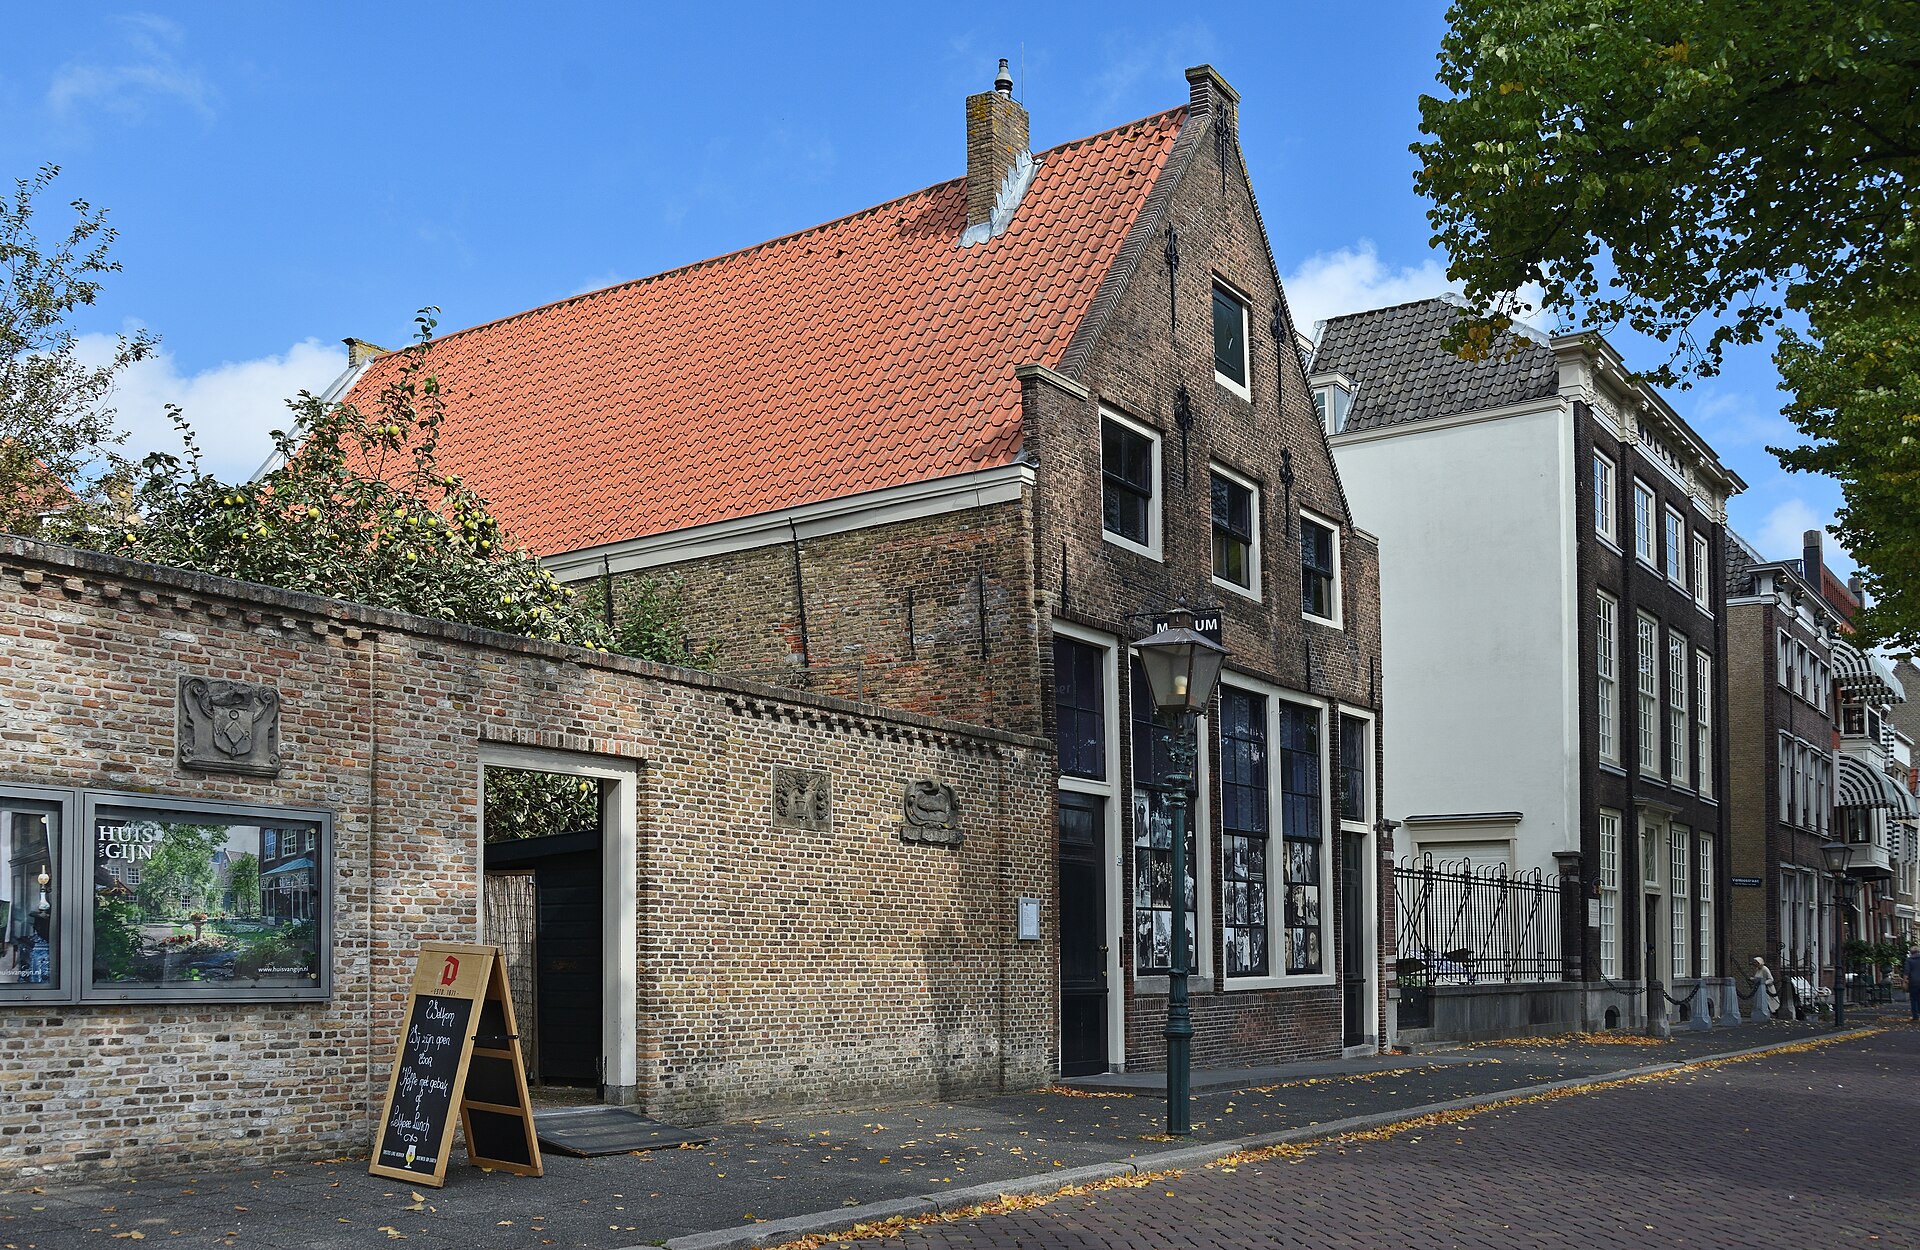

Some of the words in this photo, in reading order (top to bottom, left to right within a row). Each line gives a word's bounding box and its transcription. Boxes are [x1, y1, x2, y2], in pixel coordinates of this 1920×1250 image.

[1156, 618, 1218, 634] MUM
[97, 825, 154, 843] HUIS
[105, 843, 153, 864] GIJN
[257, 965, 309, 974] www.huisvangijn.nl
[425, 999, 456, 1028] Welkom
[436, 1035, 451, 1051] open
